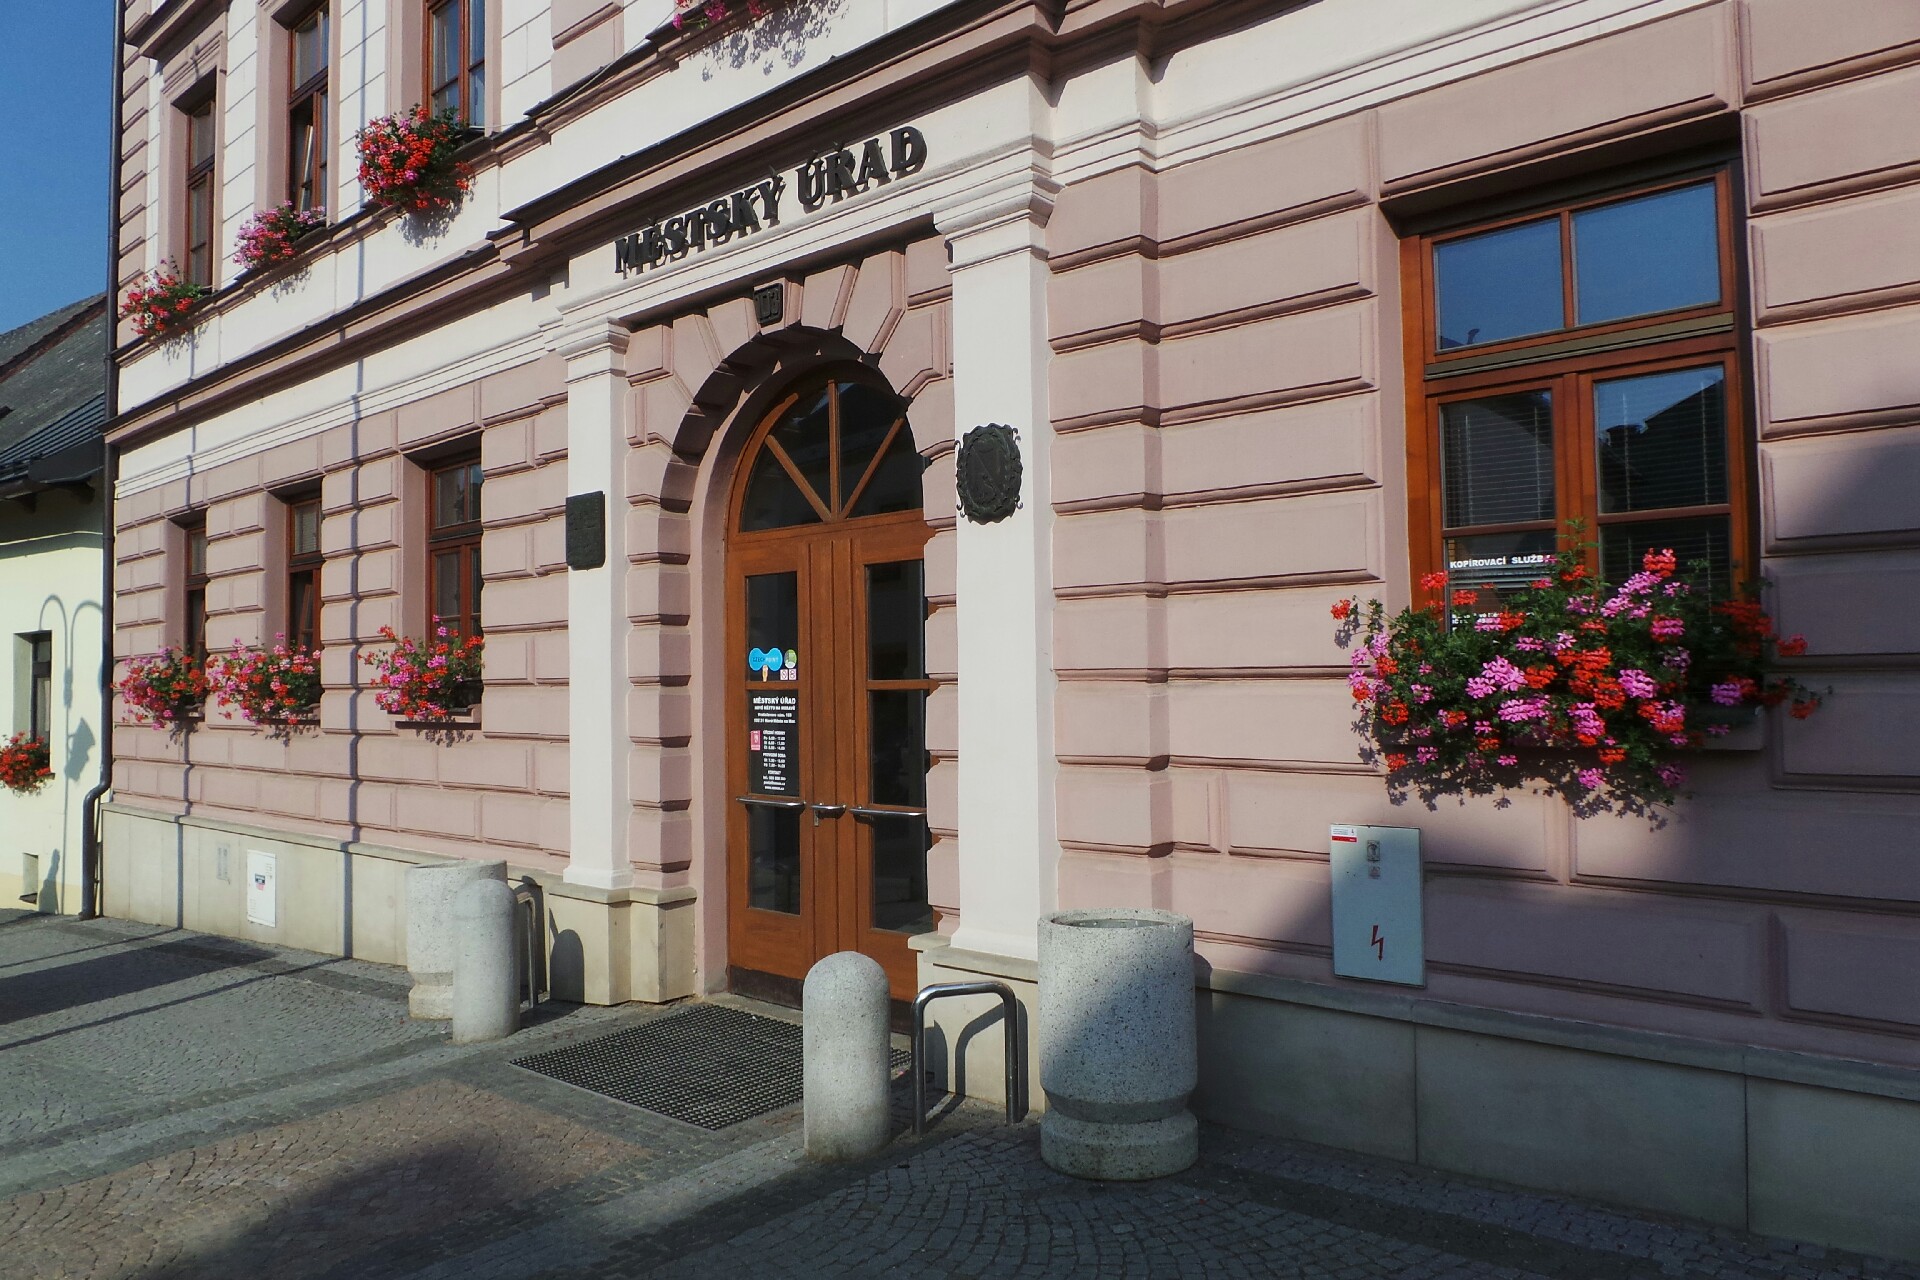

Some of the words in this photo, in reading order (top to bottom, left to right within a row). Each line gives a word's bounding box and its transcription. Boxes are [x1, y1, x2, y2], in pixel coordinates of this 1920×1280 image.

[614, 166, 785, 273] MĚSTSKÝ
[796, 126, 927, 206] ÚŘAD
[1450, 556, 1506, 568] KOPÍROVACÍ
[753, 696, 779, 704] MĚSTSKÝ
[780, 696, 796, 704] ÚŘAD
